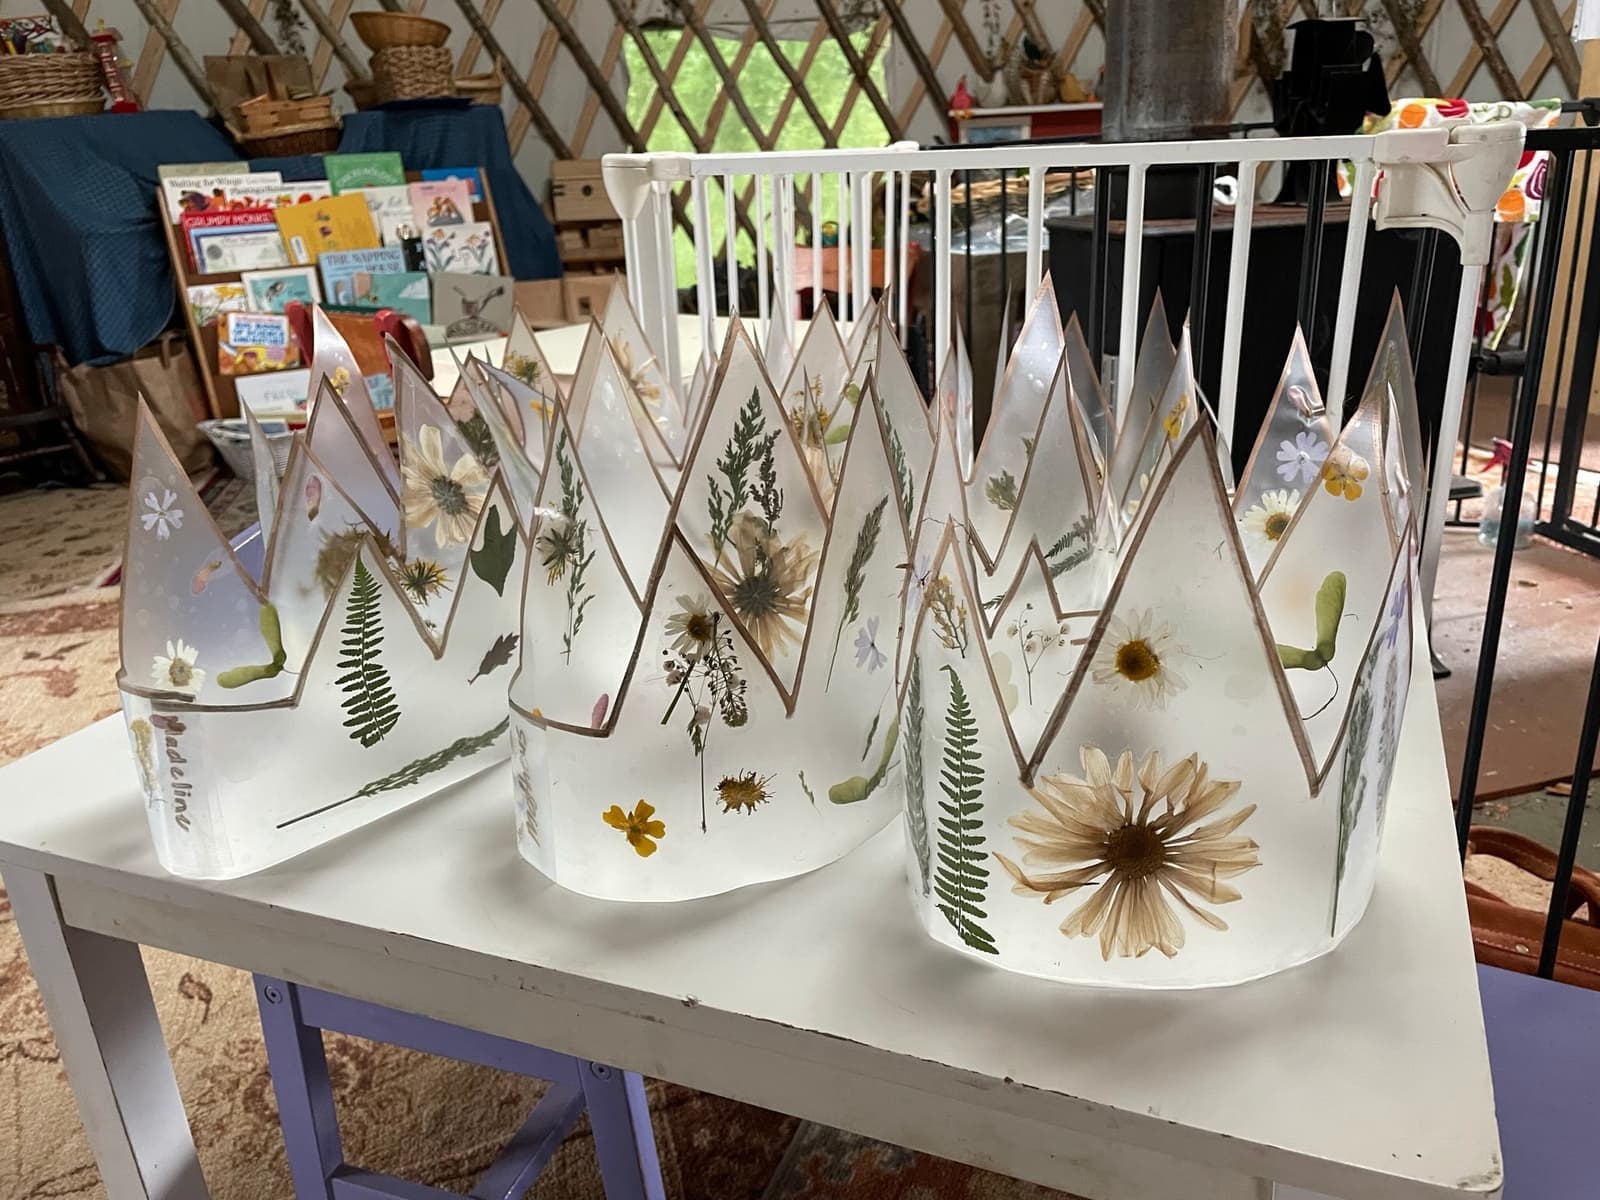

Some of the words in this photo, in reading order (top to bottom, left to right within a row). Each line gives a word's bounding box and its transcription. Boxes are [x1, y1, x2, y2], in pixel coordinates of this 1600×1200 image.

[169, 178, 200, 188] Waiting
[203, 177, 215, 186] for
[185, 215, 229, 227] GRUMPY
[326, 254, 347, 265] THE
[351, 249, 400, 263] NAPPING
[164, 715, 193, 832] Madeline
